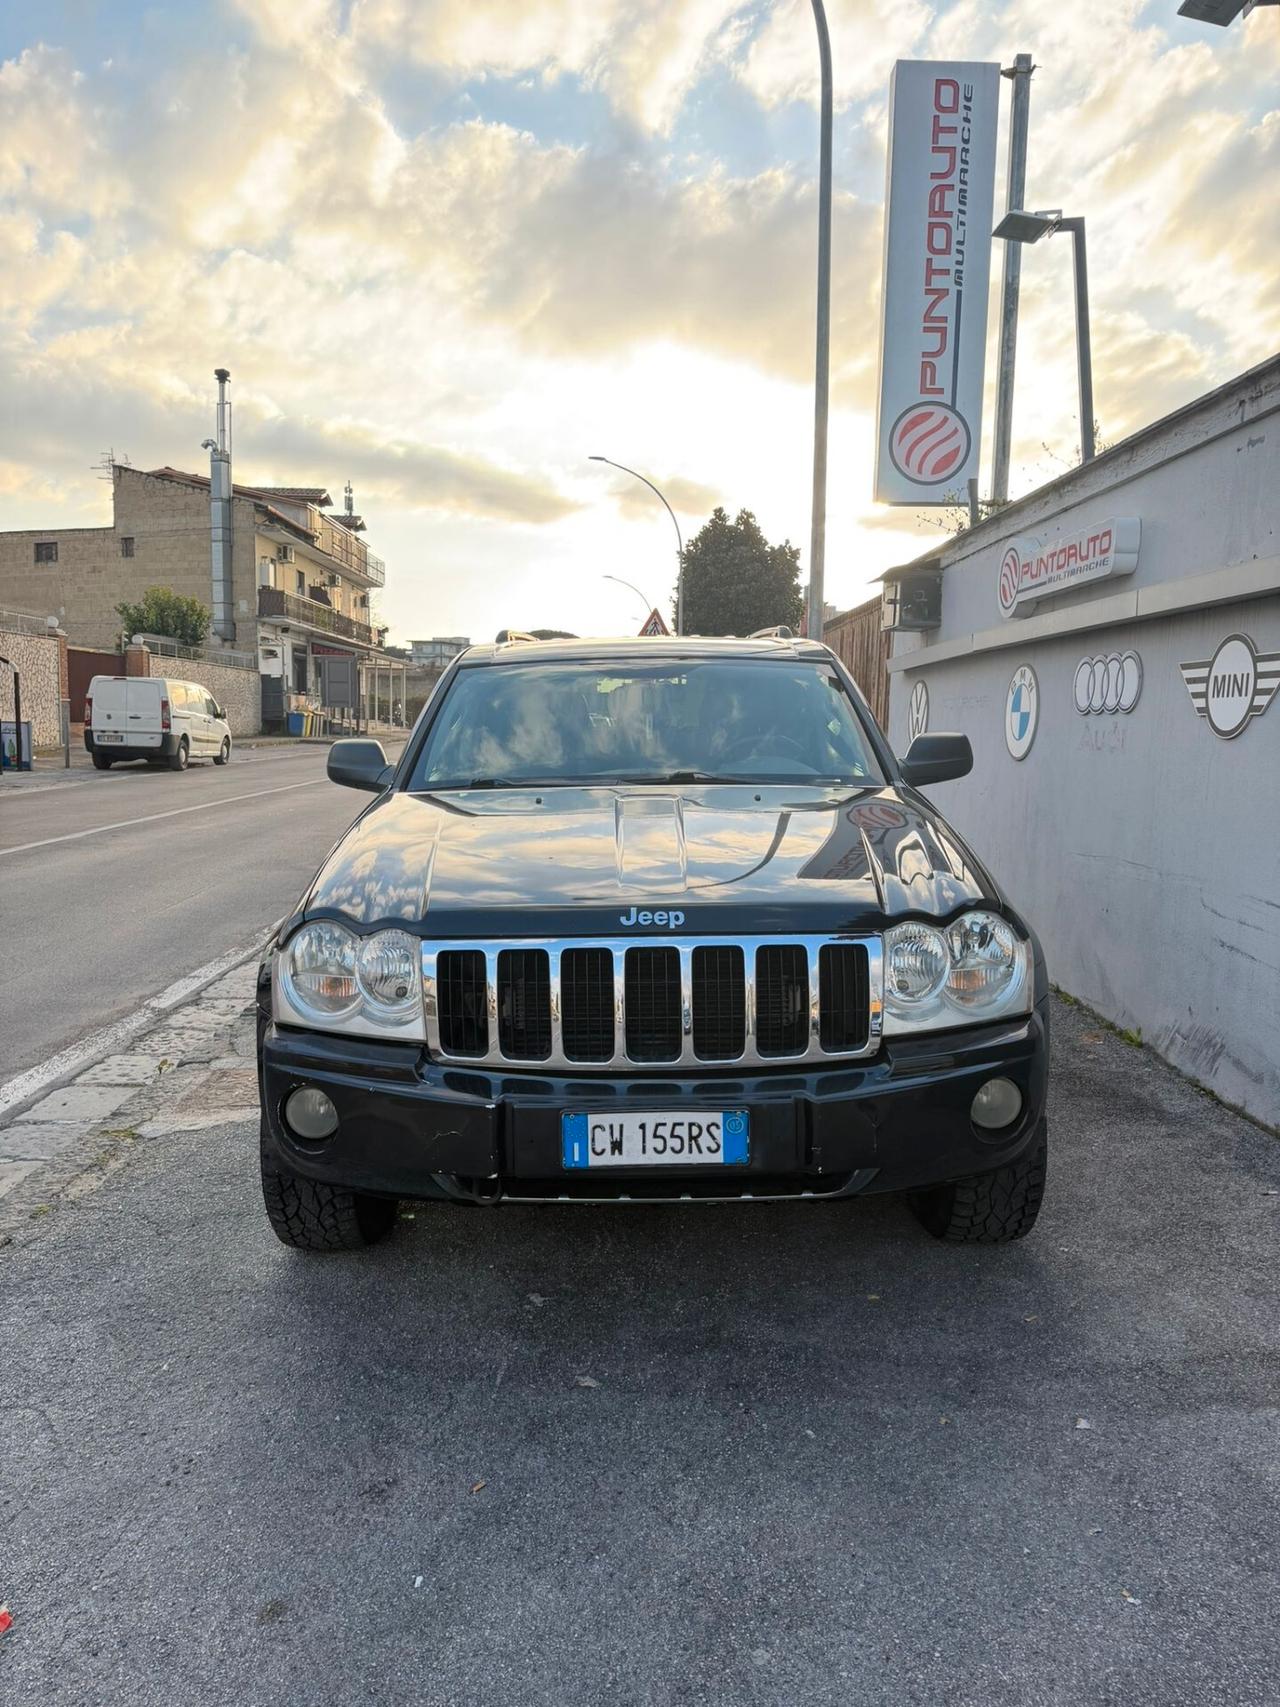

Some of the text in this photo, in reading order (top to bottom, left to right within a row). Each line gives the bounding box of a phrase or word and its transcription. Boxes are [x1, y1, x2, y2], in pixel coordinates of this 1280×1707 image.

[955, 83, 974, 288] MULTIMARCHE
[919, 78, 960, 395] PUNTOAUTO
[1020, 529, 1112, 583] PUNTOAUTO
[1047, 557, 1109, 584] MULTIMARCHE
[1010, 669, 1034, 695] BMW
[1212, 672, 1250, 698] MINI
[620, 907, 685, 929] Jeep
